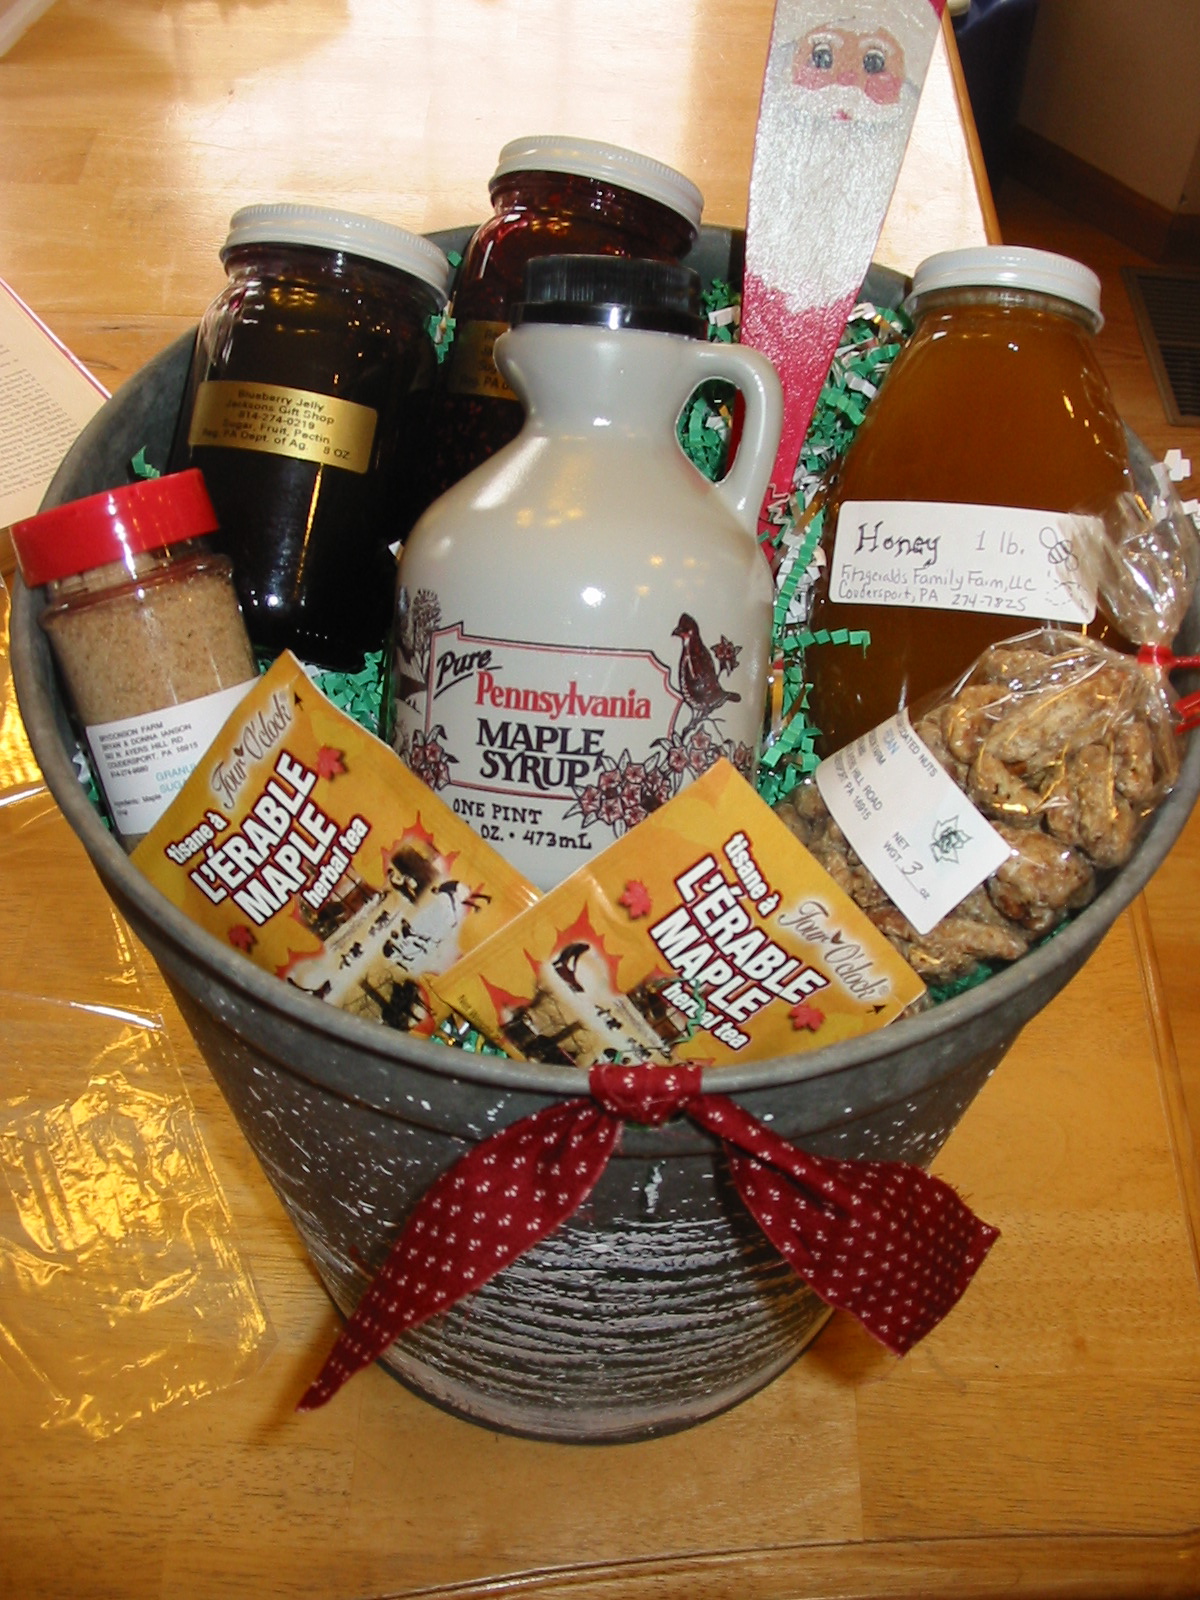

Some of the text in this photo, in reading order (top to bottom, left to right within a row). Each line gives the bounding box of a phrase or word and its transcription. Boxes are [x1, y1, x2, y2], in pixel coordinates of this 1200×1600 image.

[226, 399, 335, 426] Jacksons Gift Shop
[238, 389, 325, 412] Blueberry Jelly
[239, 410, 315, 430] 814-274-0219
[261, 423, 289, 437] Fruit,
[294, 429, 330, 445] Pectin
[274, 437, 286, 445] of
[334, 448, 350, 460] OZ
[854, 521, 1025, 567] Honey 1 lb.
[913, 571, 963, 592] Family
[920, 590, 939, 602] PA
[951, 594, 1028, 612] 274-7825
[436, 650, 494, 689] Pure
[475, 670, 651, 720] Pennsylvania
[140, 722, 163, 733] FARM
[476, 718, 604, 756] MAPLE
[151, 741, 168, 750] HILL
[171, 736, 183, 744] RD
[480, 751, 591, 790] SYRUP
[918, 754, 938, 777] NUTS
[844, 782, 855, 796] PA
[863, 785, 883, 811] ROAD
[453, 798, 542, 824] ONE PINT
[190, 752, 317, 904] L'ÉRABLE
[480, 825, 592, 850] OZ. 473mL
[892, 832, 910, 850] NET
[167, 823, 214, 864] tisane
[233, 802, 337, 925] MAPLE
[303, 817, 369, 910] herbal tea
[724, 832, 769, 900] tisane
[883, 841, 902, 863] WGT
[902, 861, 924, 875] 3
[675, 855, 830, 1004] L'ÉRABLE
[649, 907, 773, 1023] MAPLE
[713, 1021, 750, 1050] tea
